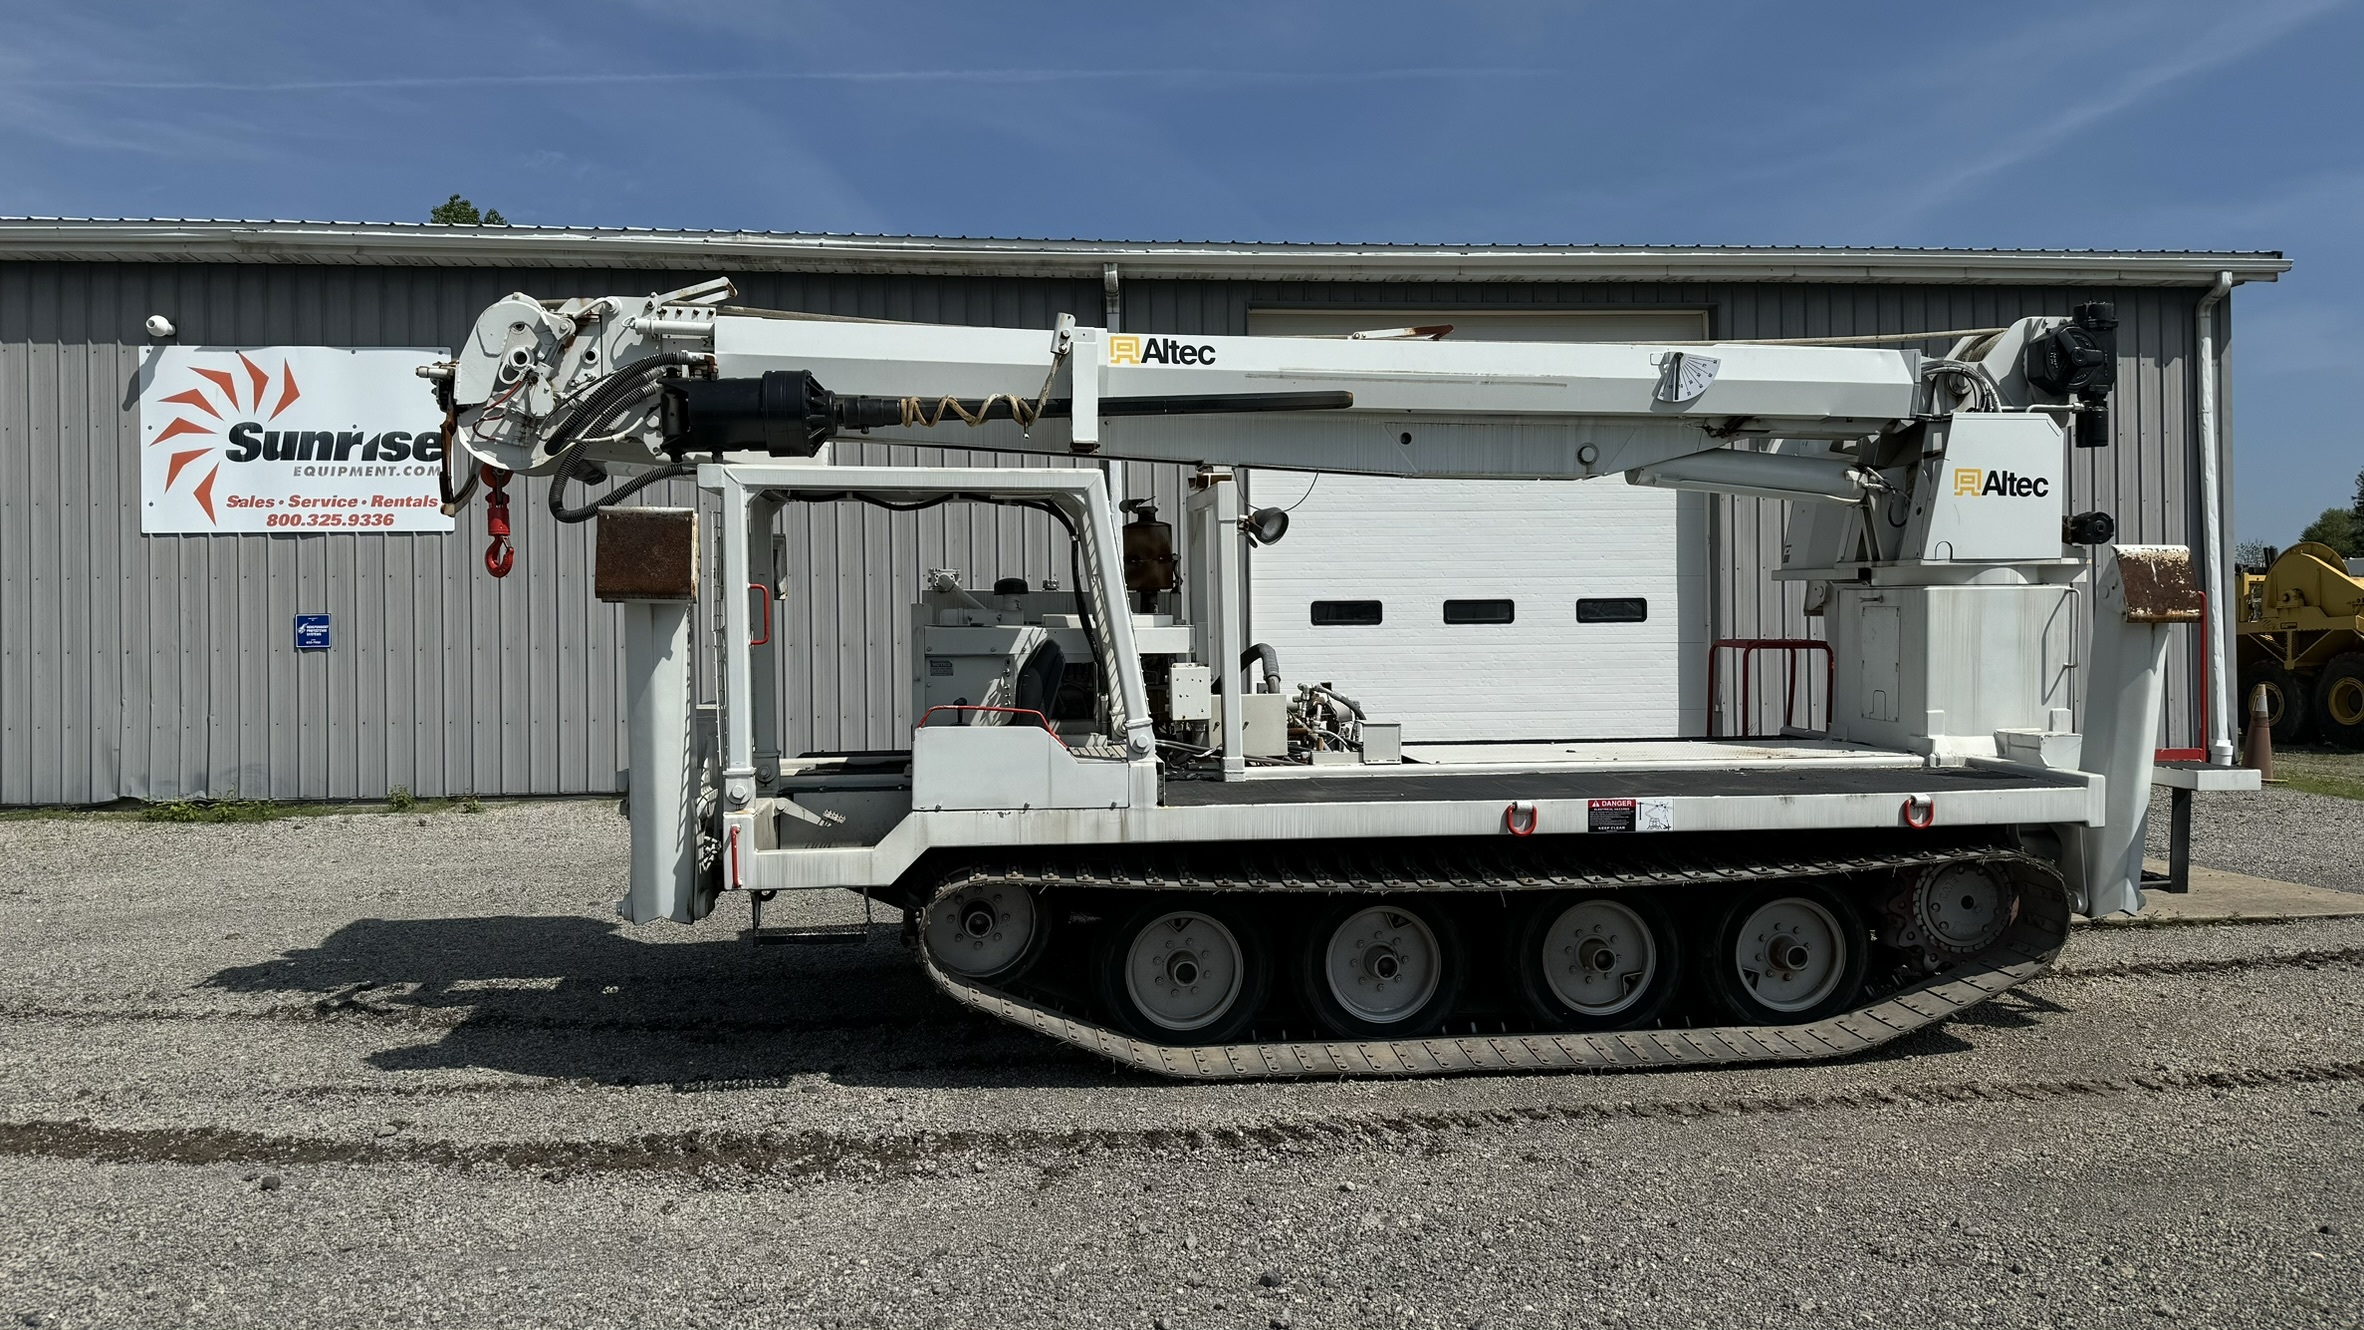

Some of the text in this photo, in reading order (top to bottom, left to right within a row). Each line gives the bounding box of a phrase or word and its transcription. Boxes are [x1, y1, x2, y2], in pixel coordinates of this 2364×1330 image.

[1141, 338, 1216, 365] Altec
[226, 422, 442, 462] Sunrise
[293, 466, 440, 477] EQUIPMENT.COM
[1981, 470, 2049, 497] Altec
[226, 495, 438, 508] Sales Service Rentals
[266, 513, 395, 527] 800.325.9336
